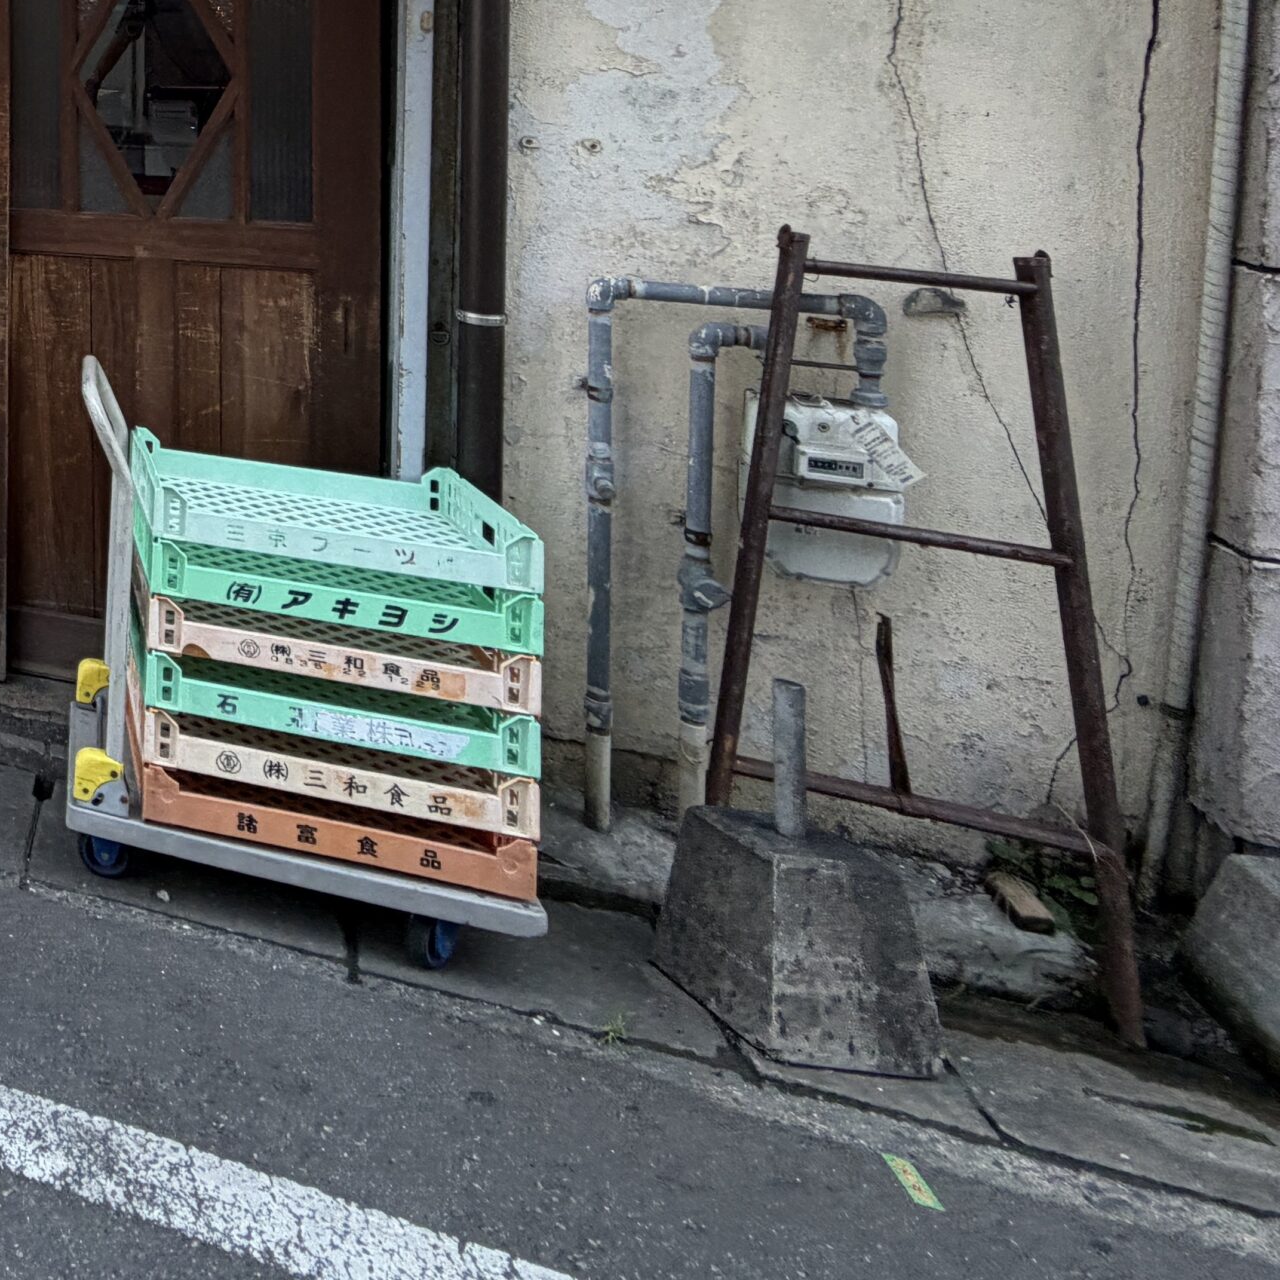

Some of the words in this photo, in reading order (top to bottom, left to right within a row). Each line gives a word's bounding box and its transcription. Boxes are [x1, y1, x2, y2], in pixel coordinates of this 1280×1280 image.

[263, 758, 453, 817] (株)三和食品
[236, 811, 442, 871] 諸富食品
